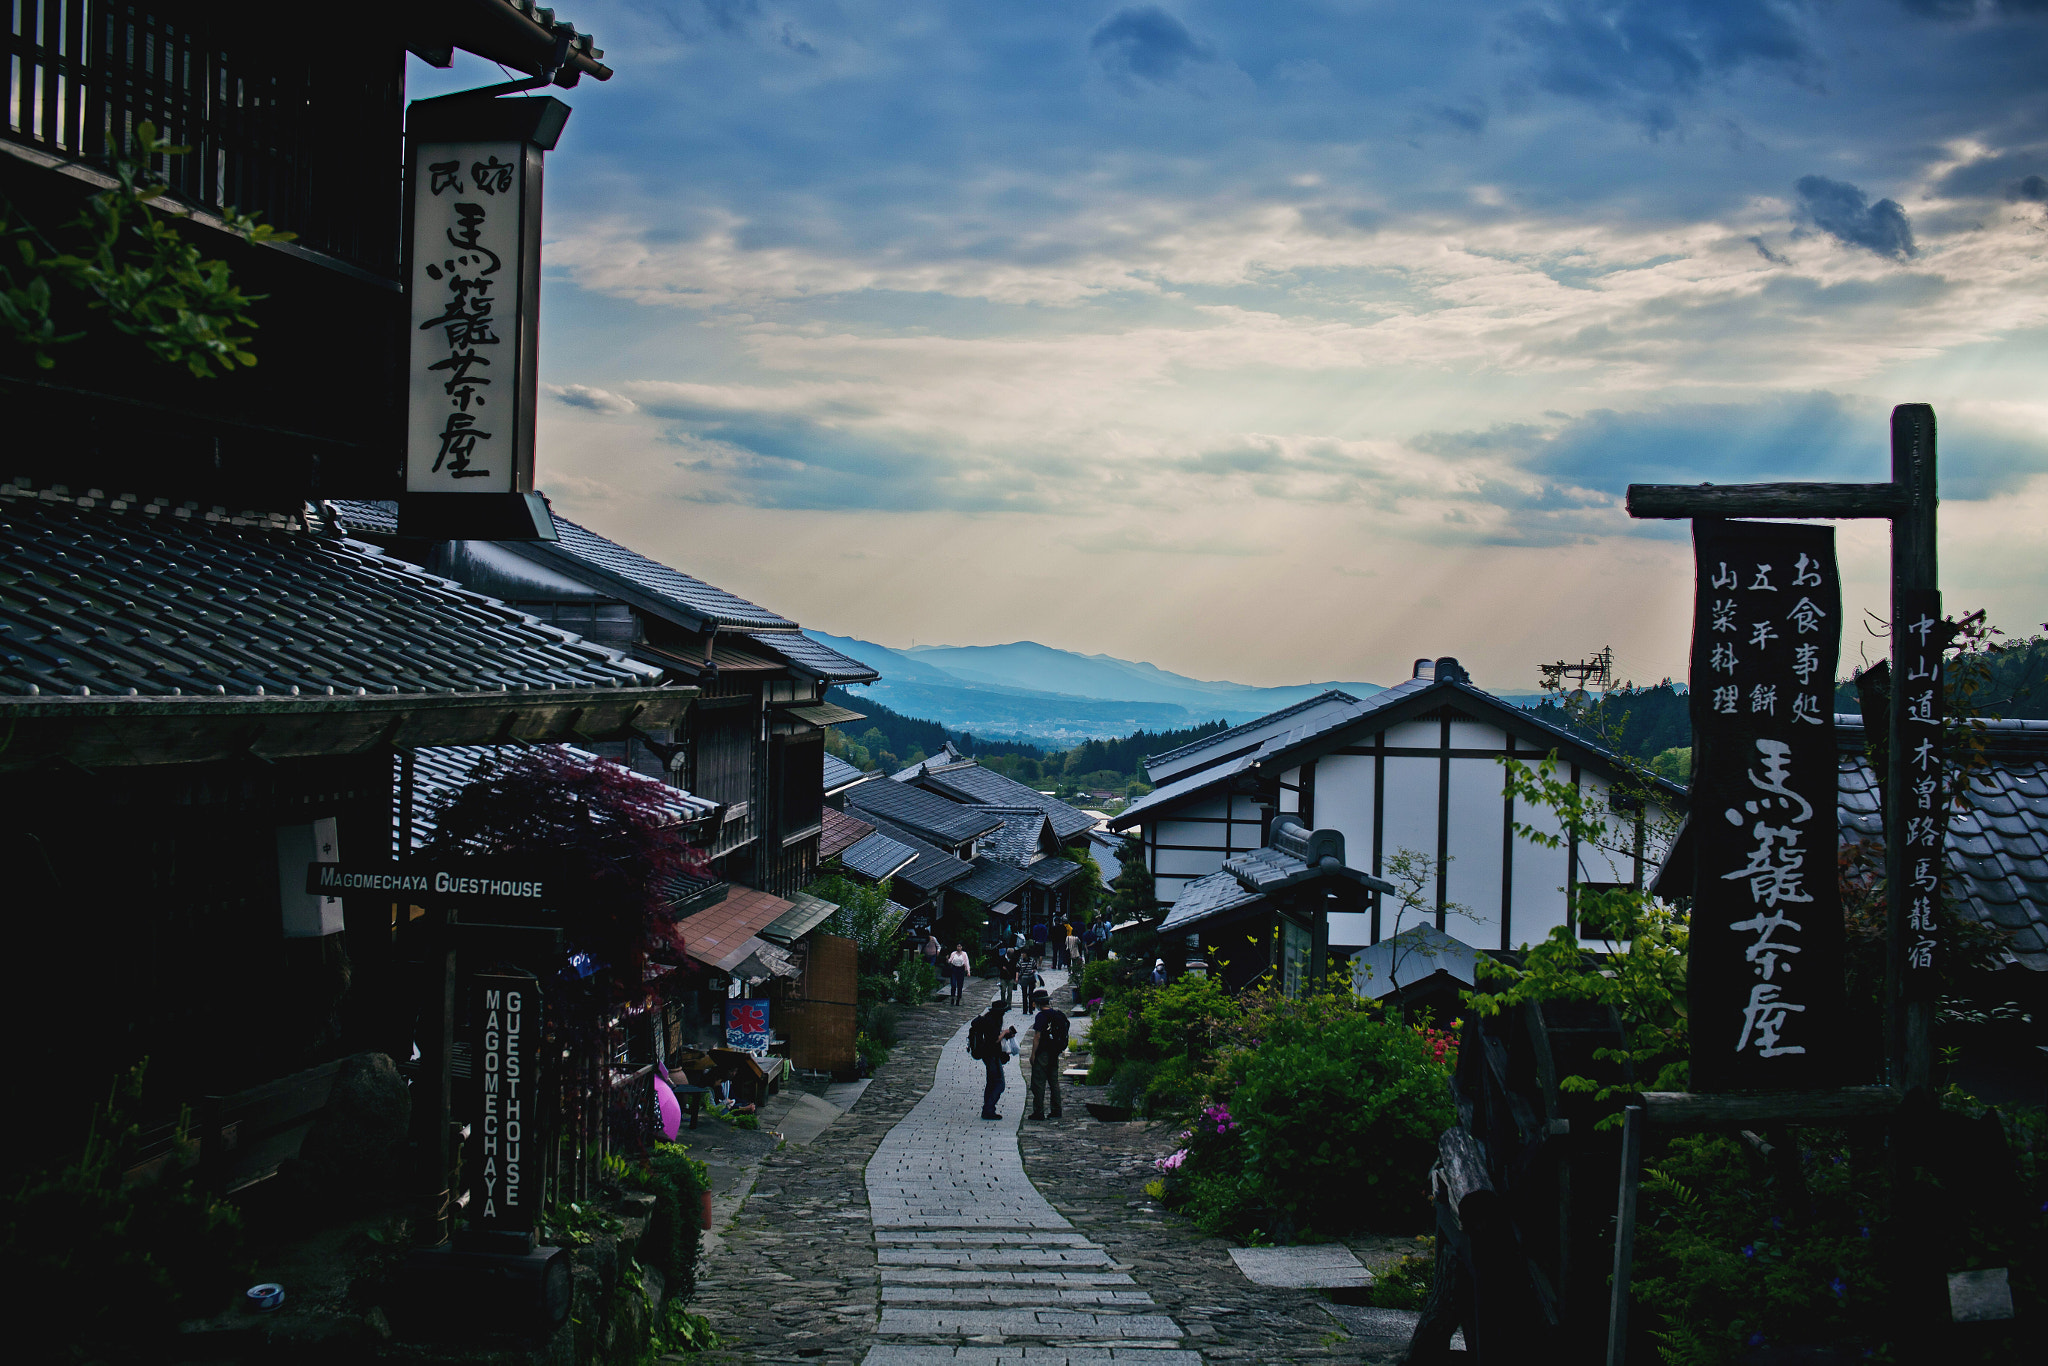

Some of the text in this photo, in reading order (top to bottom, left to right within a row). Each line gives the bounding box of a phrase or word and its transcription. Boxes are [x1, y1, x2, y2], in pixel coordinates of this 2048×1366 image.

[429, 155, 515, 195] 民宿
[419, 202, 502, 480] 馬籠茶屋
[1709, 561, 1740, 715] 山菜料理
[1747, 563, 1779, 718] 五平餅
[1785, 552, 1827, 726] お食事処
[1719, 738, 1816, 1059] 馬籠茶屋
[482, 989, 501, 1218] MAGOMECHAYA
[505, 990, 522, 1207] GUESTHOUSE
